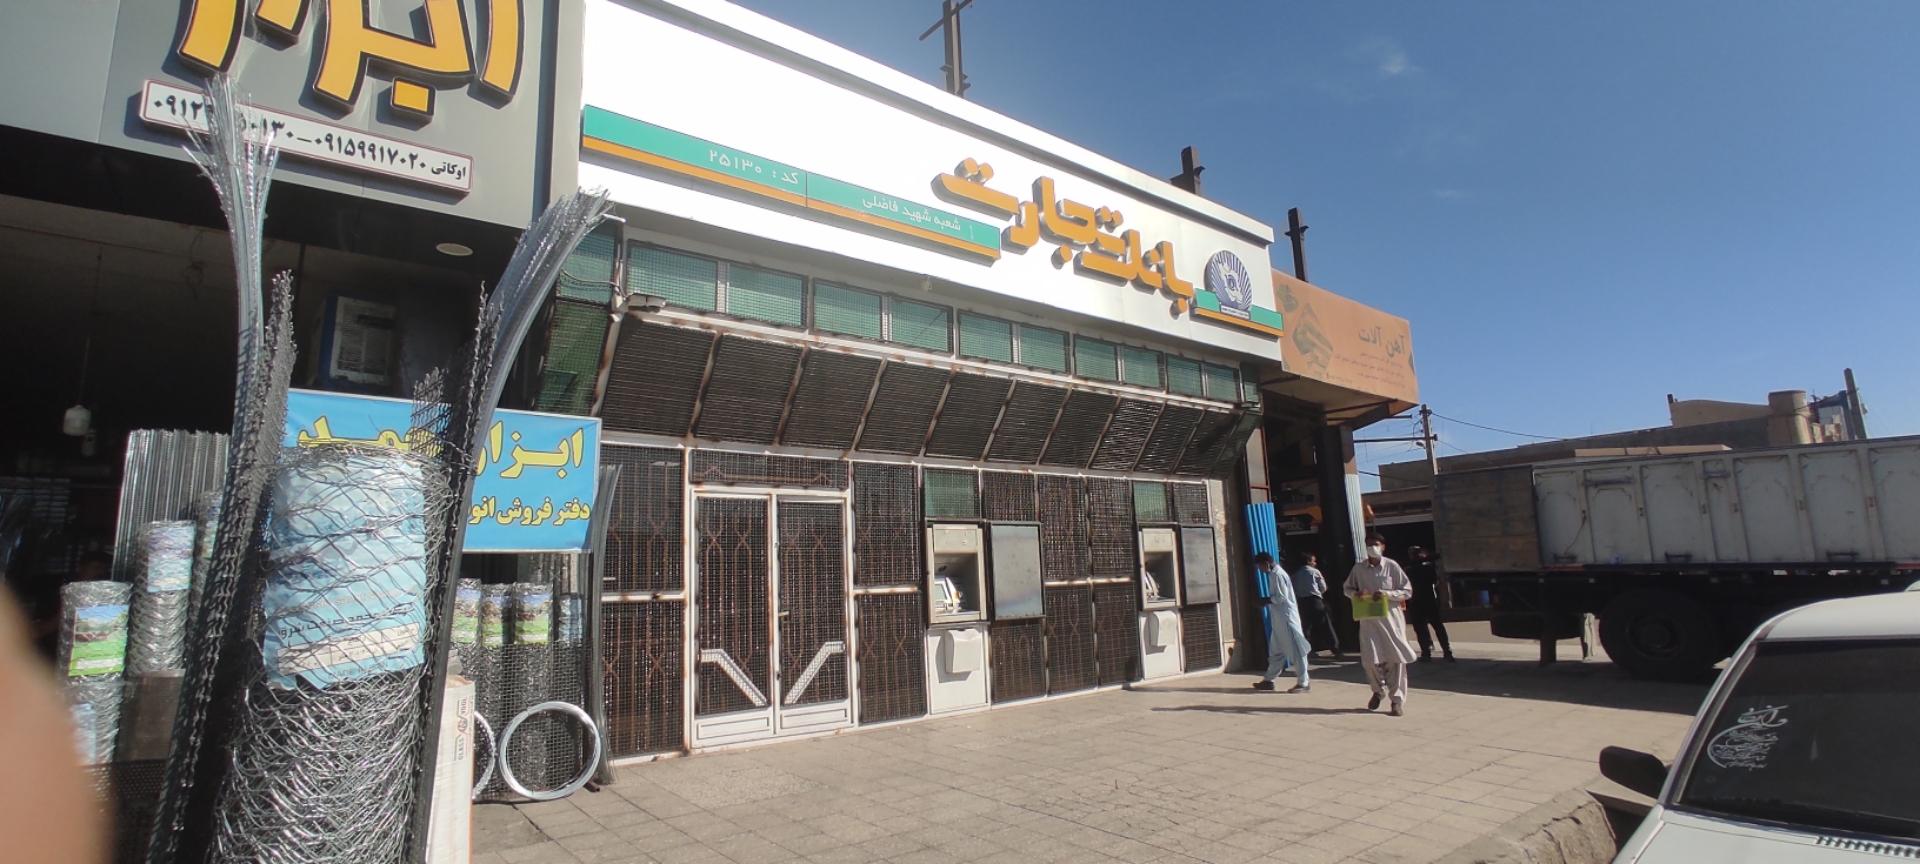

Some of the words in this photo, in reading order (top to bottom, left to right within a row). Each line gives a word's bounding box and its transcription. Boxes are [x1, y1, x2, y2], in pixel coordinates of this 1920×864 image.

[315, 132, 427, 170] ۰۹۱۵۹۹۱۷۰۲۰
[708, 149, 763, 174] ۲۵۱۳۰
[861, 195, 899, 213] فاضلی
[901, 205, 932, 223] شهید
[932, 157, 1125, 264] تجارت
[932, 216, 962, 231] شعبه
[1075, 229, 1194, 318] بانک
[467, 496, 496, 525] انو
[496, 496, 554, 526] فروش
[552, 496, 592, 526] دفتر
